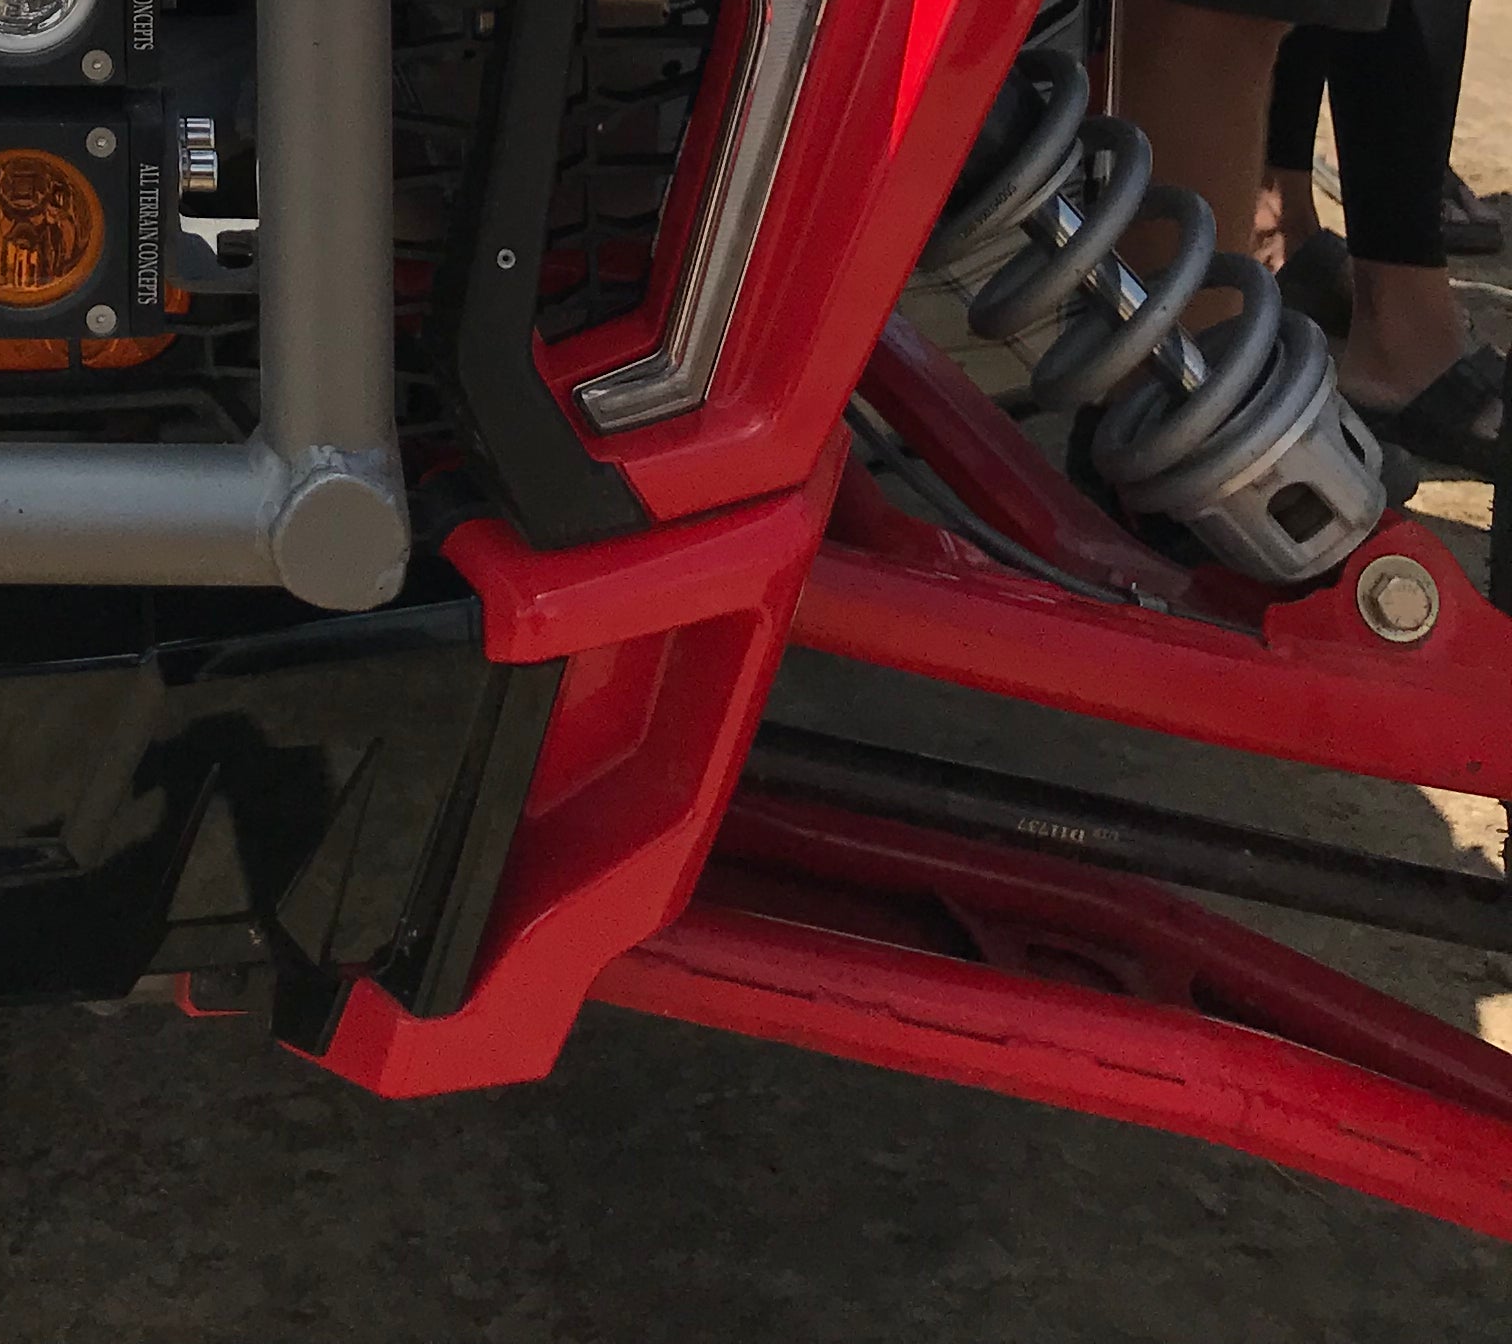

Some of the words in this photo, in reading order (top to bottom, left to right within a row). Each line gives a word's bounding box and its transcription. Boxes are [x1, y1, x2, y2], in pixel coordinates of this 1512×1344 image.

[139, 162, 160, 186] ALL
[138, 187, 160, 241] TERRAIN
[137, 242, 159, 305] CONCEPTS
